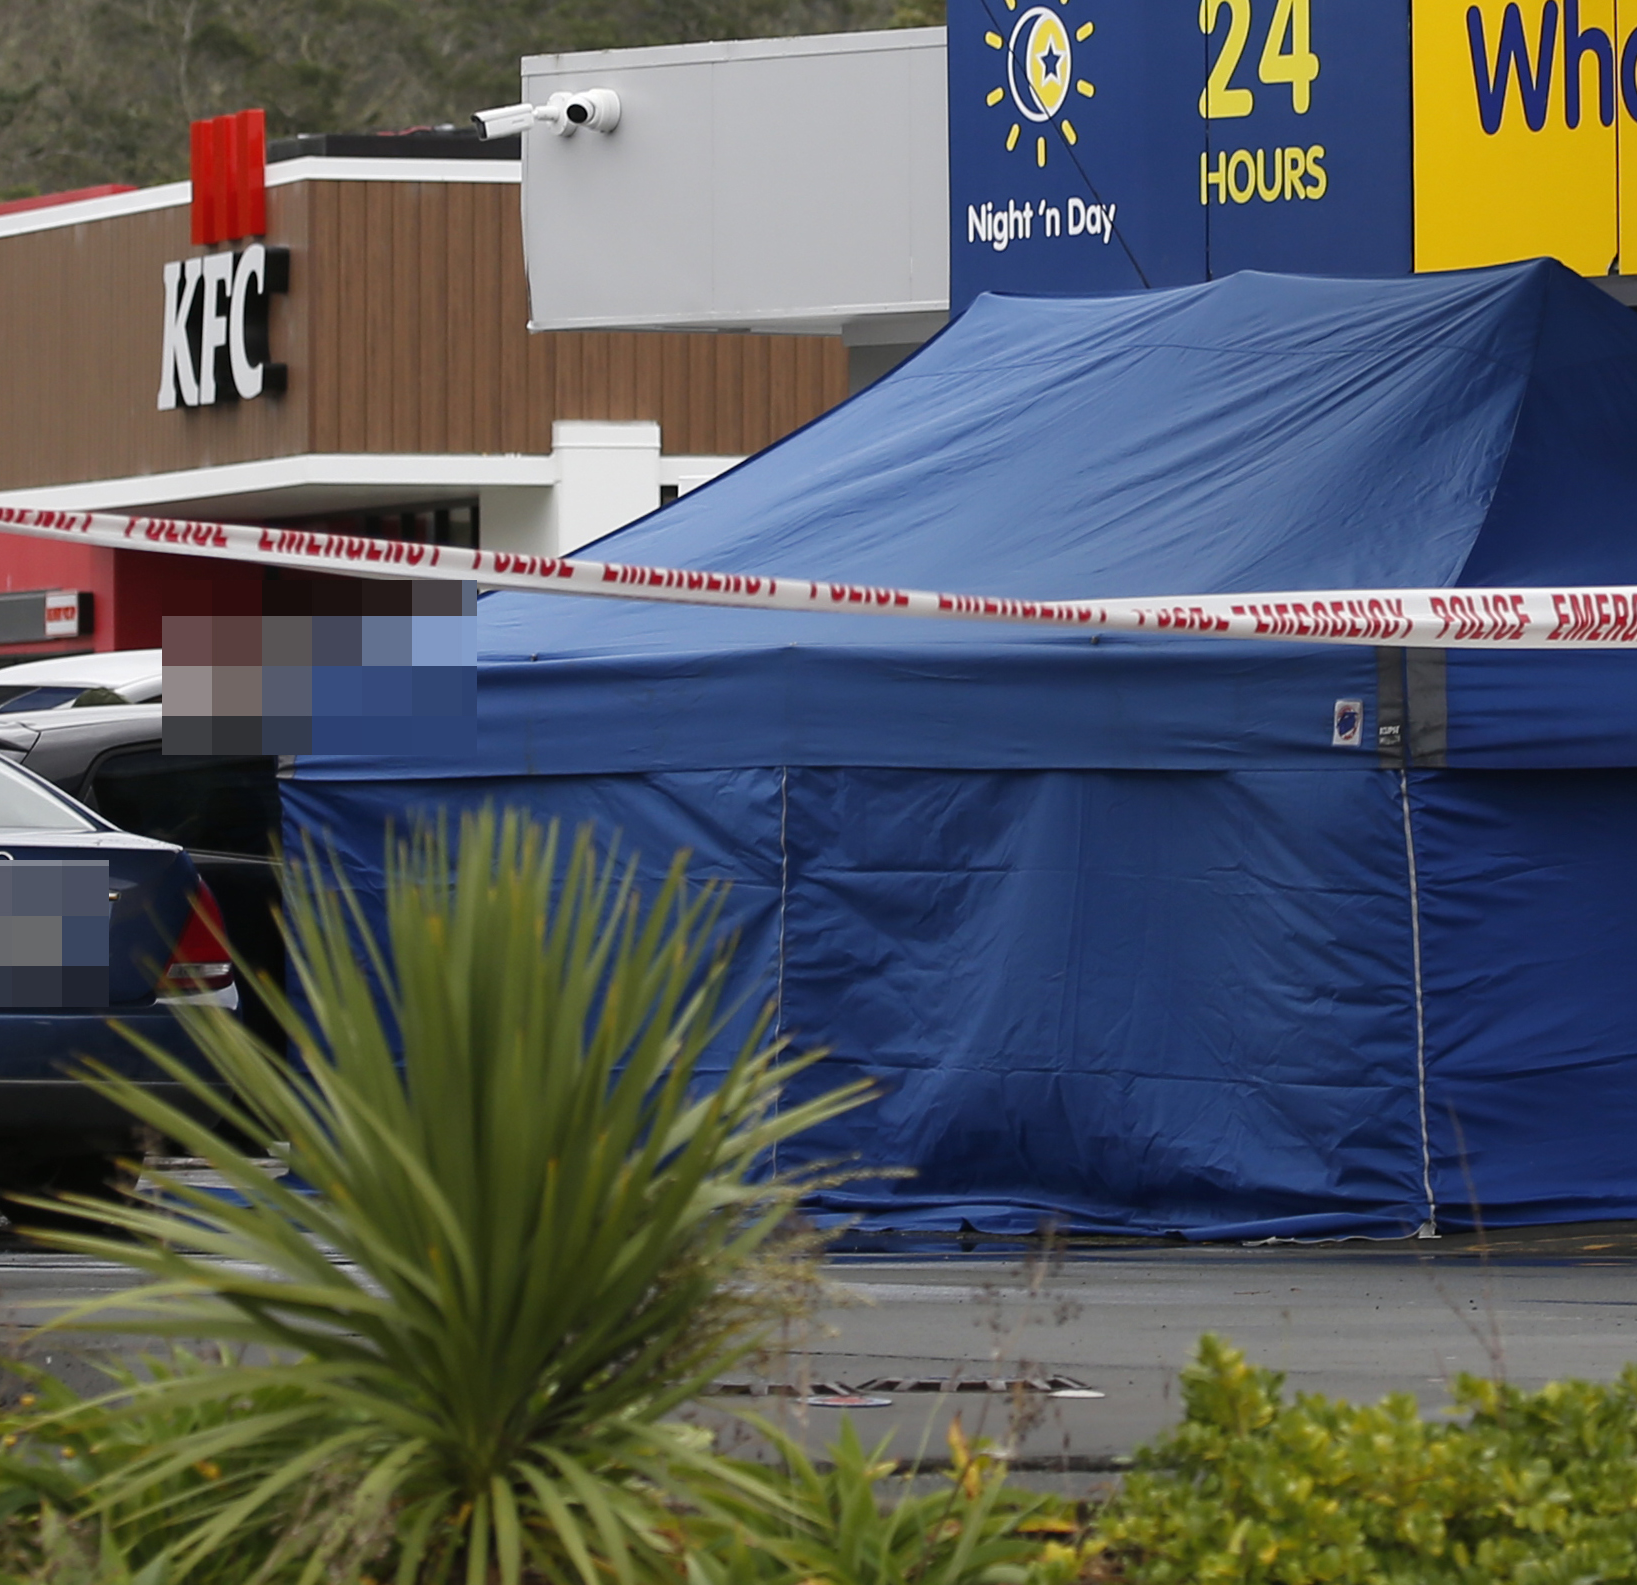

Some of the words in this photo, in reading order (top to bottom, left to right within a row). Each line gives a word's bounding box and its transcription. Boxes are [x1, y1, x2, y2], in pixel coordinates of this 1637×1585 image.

[1199, 144, 1328, 206] HOURS
[967, 197, 1033, 252] Night
[1067, 197, 1116, 244] Day
[157, 242, 264, 411] KFC
[1429, 594, 1530, 641] POLICE
